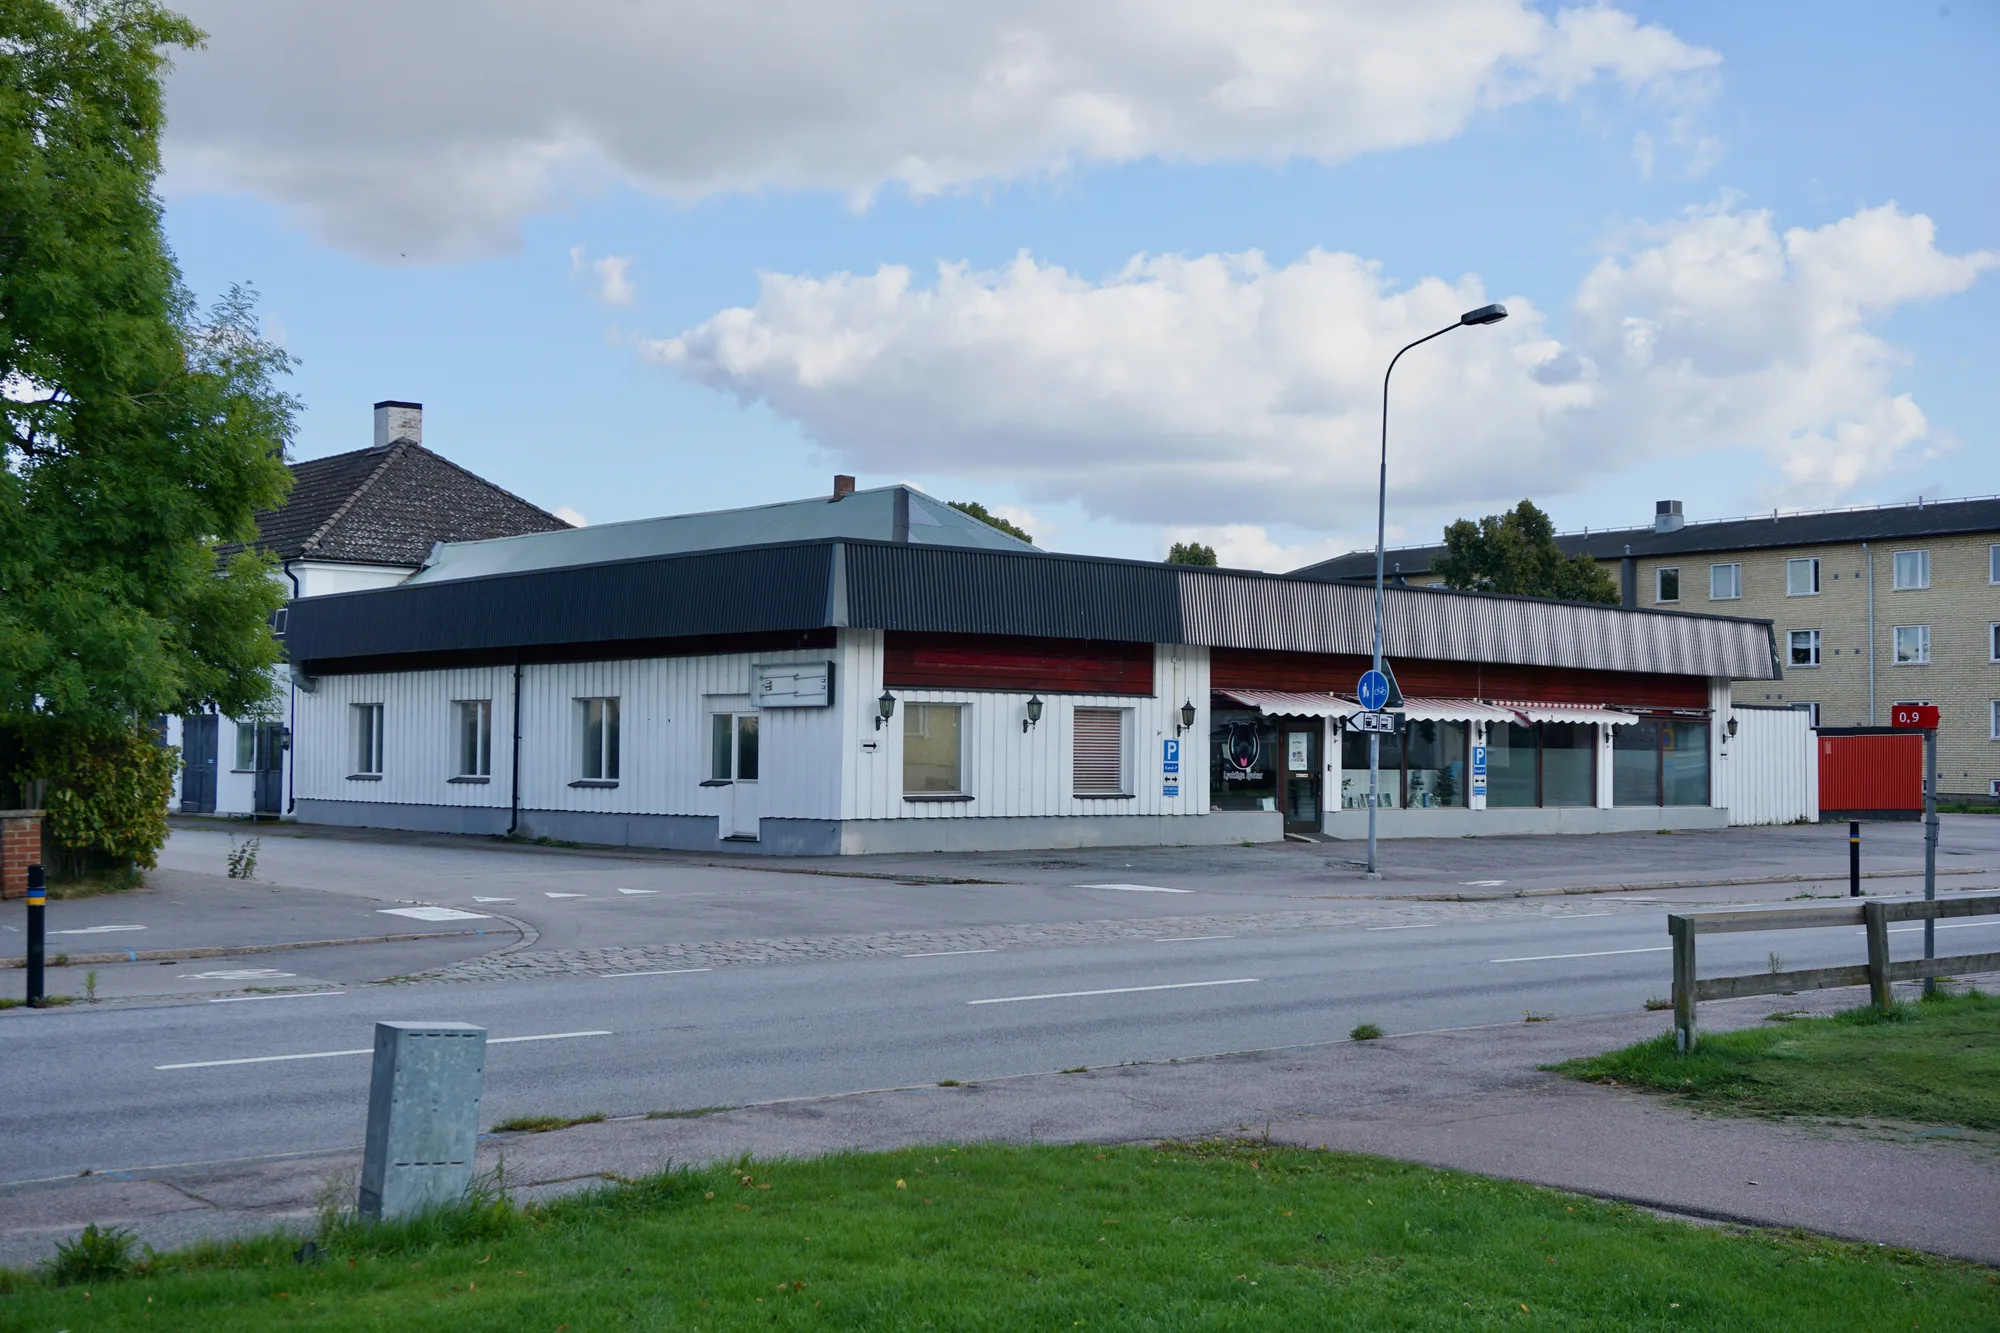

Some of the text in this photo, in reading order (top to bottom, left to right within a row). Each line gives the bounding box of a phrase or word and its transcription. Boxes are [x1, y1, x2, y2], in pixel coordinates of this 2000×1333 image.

[1899, 711, 1919, 724] 0,9
[1167, 741, 1177, 760] P
[1476, 748, 1484, 764] P
